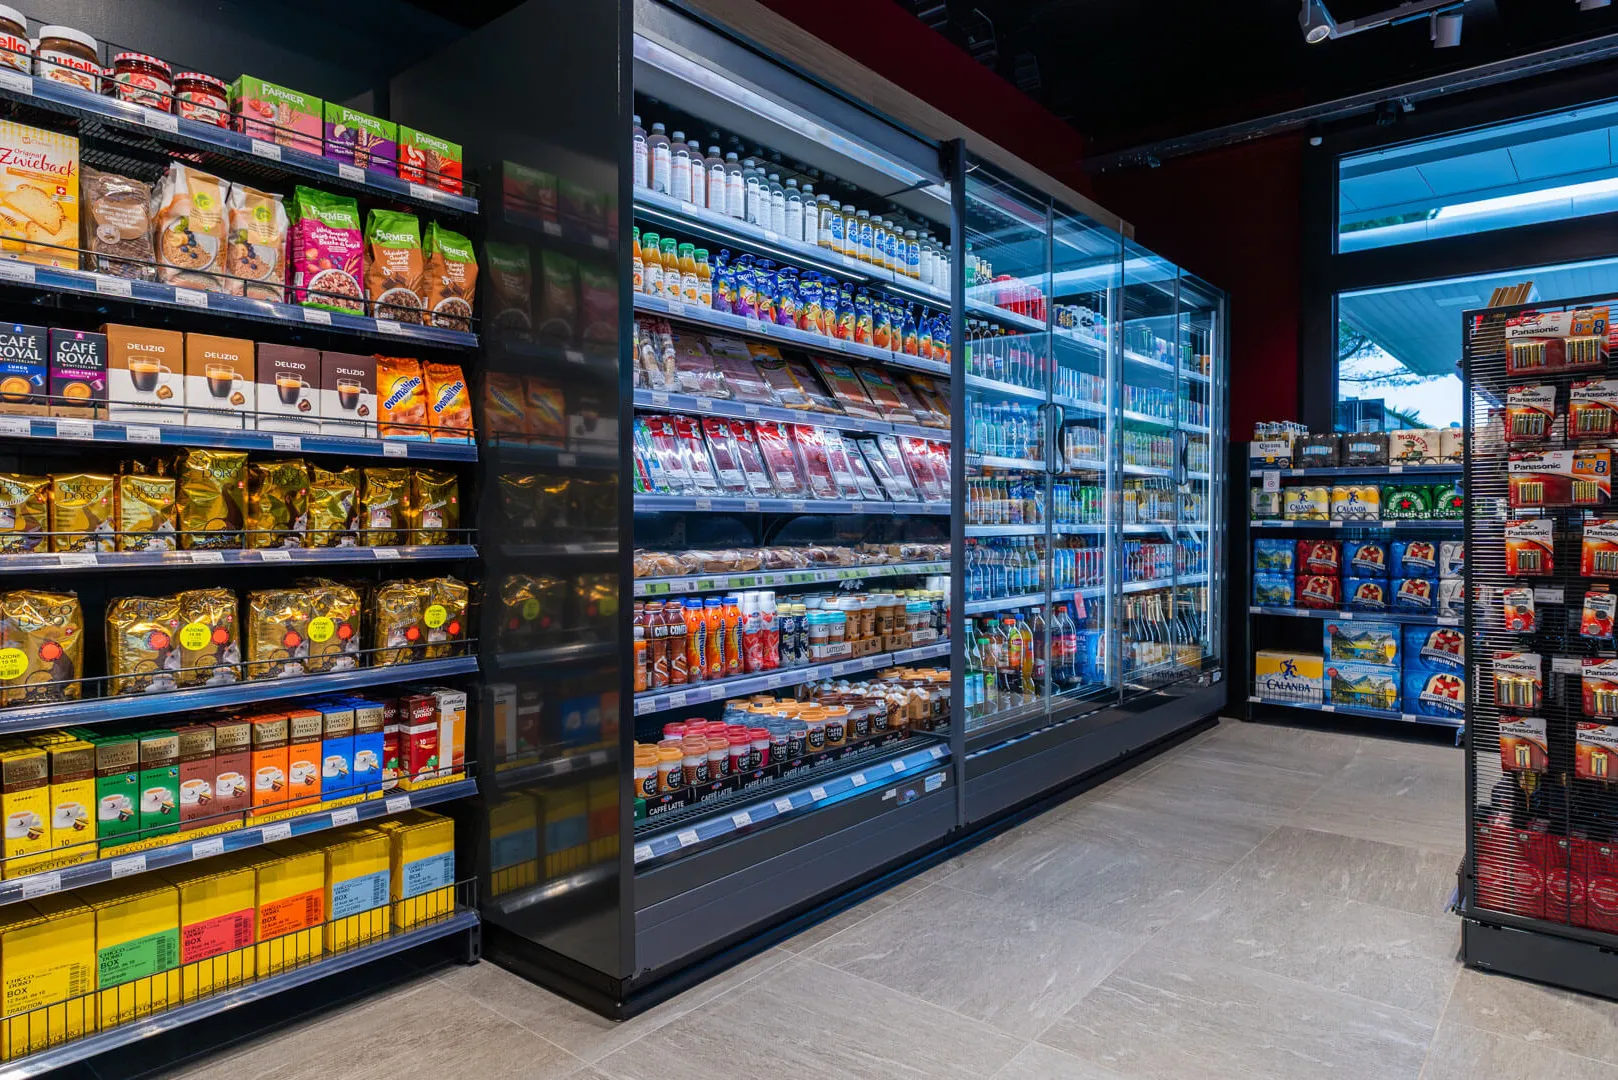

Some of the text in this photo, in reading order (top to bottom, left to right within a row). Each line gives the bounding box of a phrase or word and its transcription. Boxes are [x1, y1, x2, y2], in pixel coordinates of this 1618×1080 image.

[48, 54, 100, 76] nutella
[262, 83, 304, 107] FARMER
[343, 110, 381, 131] FARMER
[416, 132, 449, 153] FARMER
[14, 148, 42, 158] Original
[0, 146, 76, 178] Zwieback
[375, 229, 416, 244] FARMER
[1511, 319, 1605, 336] Panasonic 8 8
[0, 334, 36, 349] CAFÉ
[60, 341, 97, 355] CAFÉ
[127, 343, 165, 353] DELIZIO
[56, 351, 103, 366] ROYAL
[204, 351, 239, 361] DELIZIO
[275, 360, 306, 370] DELIZIO
[336, 367, 365, 377] DELIZIO
[384, 377, 421, 410] ovomaltine
[434, 381, 464, 413] ovomaltine
[1397, 434, 1429, 453] MORETTI
[1513, 460, 1607, 474] Panasonic 8 8
[60, 484, 104, 493] CHICCO
[64, 491, 99, 500] DORO
[1289, 503, 1315, 511] CALANDA
[1336, 504, 1367, 513] CALANDA
[1383, 508, 1431, 520] Heineken
[1427, 655, 1457, 668] ORIGINAL
[1494, 662, 1537, 671] Panasonic
[1266, 679, 1310, 693] CALANDA
[1501, 726, 1543, 735] Panasonic
[717, 787, 732, 797] LATTE
[648, 800, 684, 815] CAFFÈ LATTE
[15, 848, 25, 857] 10
[109, 838, 169, 856] CHICCO DORO
[17, 856, 83, 877] CHICCO DORO
[261, 915, 277, 924] BOX
[185, 936, 202, 947] BOX
[100, 958, 119, 969] BOX
[7, 987, 27, 998] BOX
[7, 1001, 43, 1015] TRADITION
